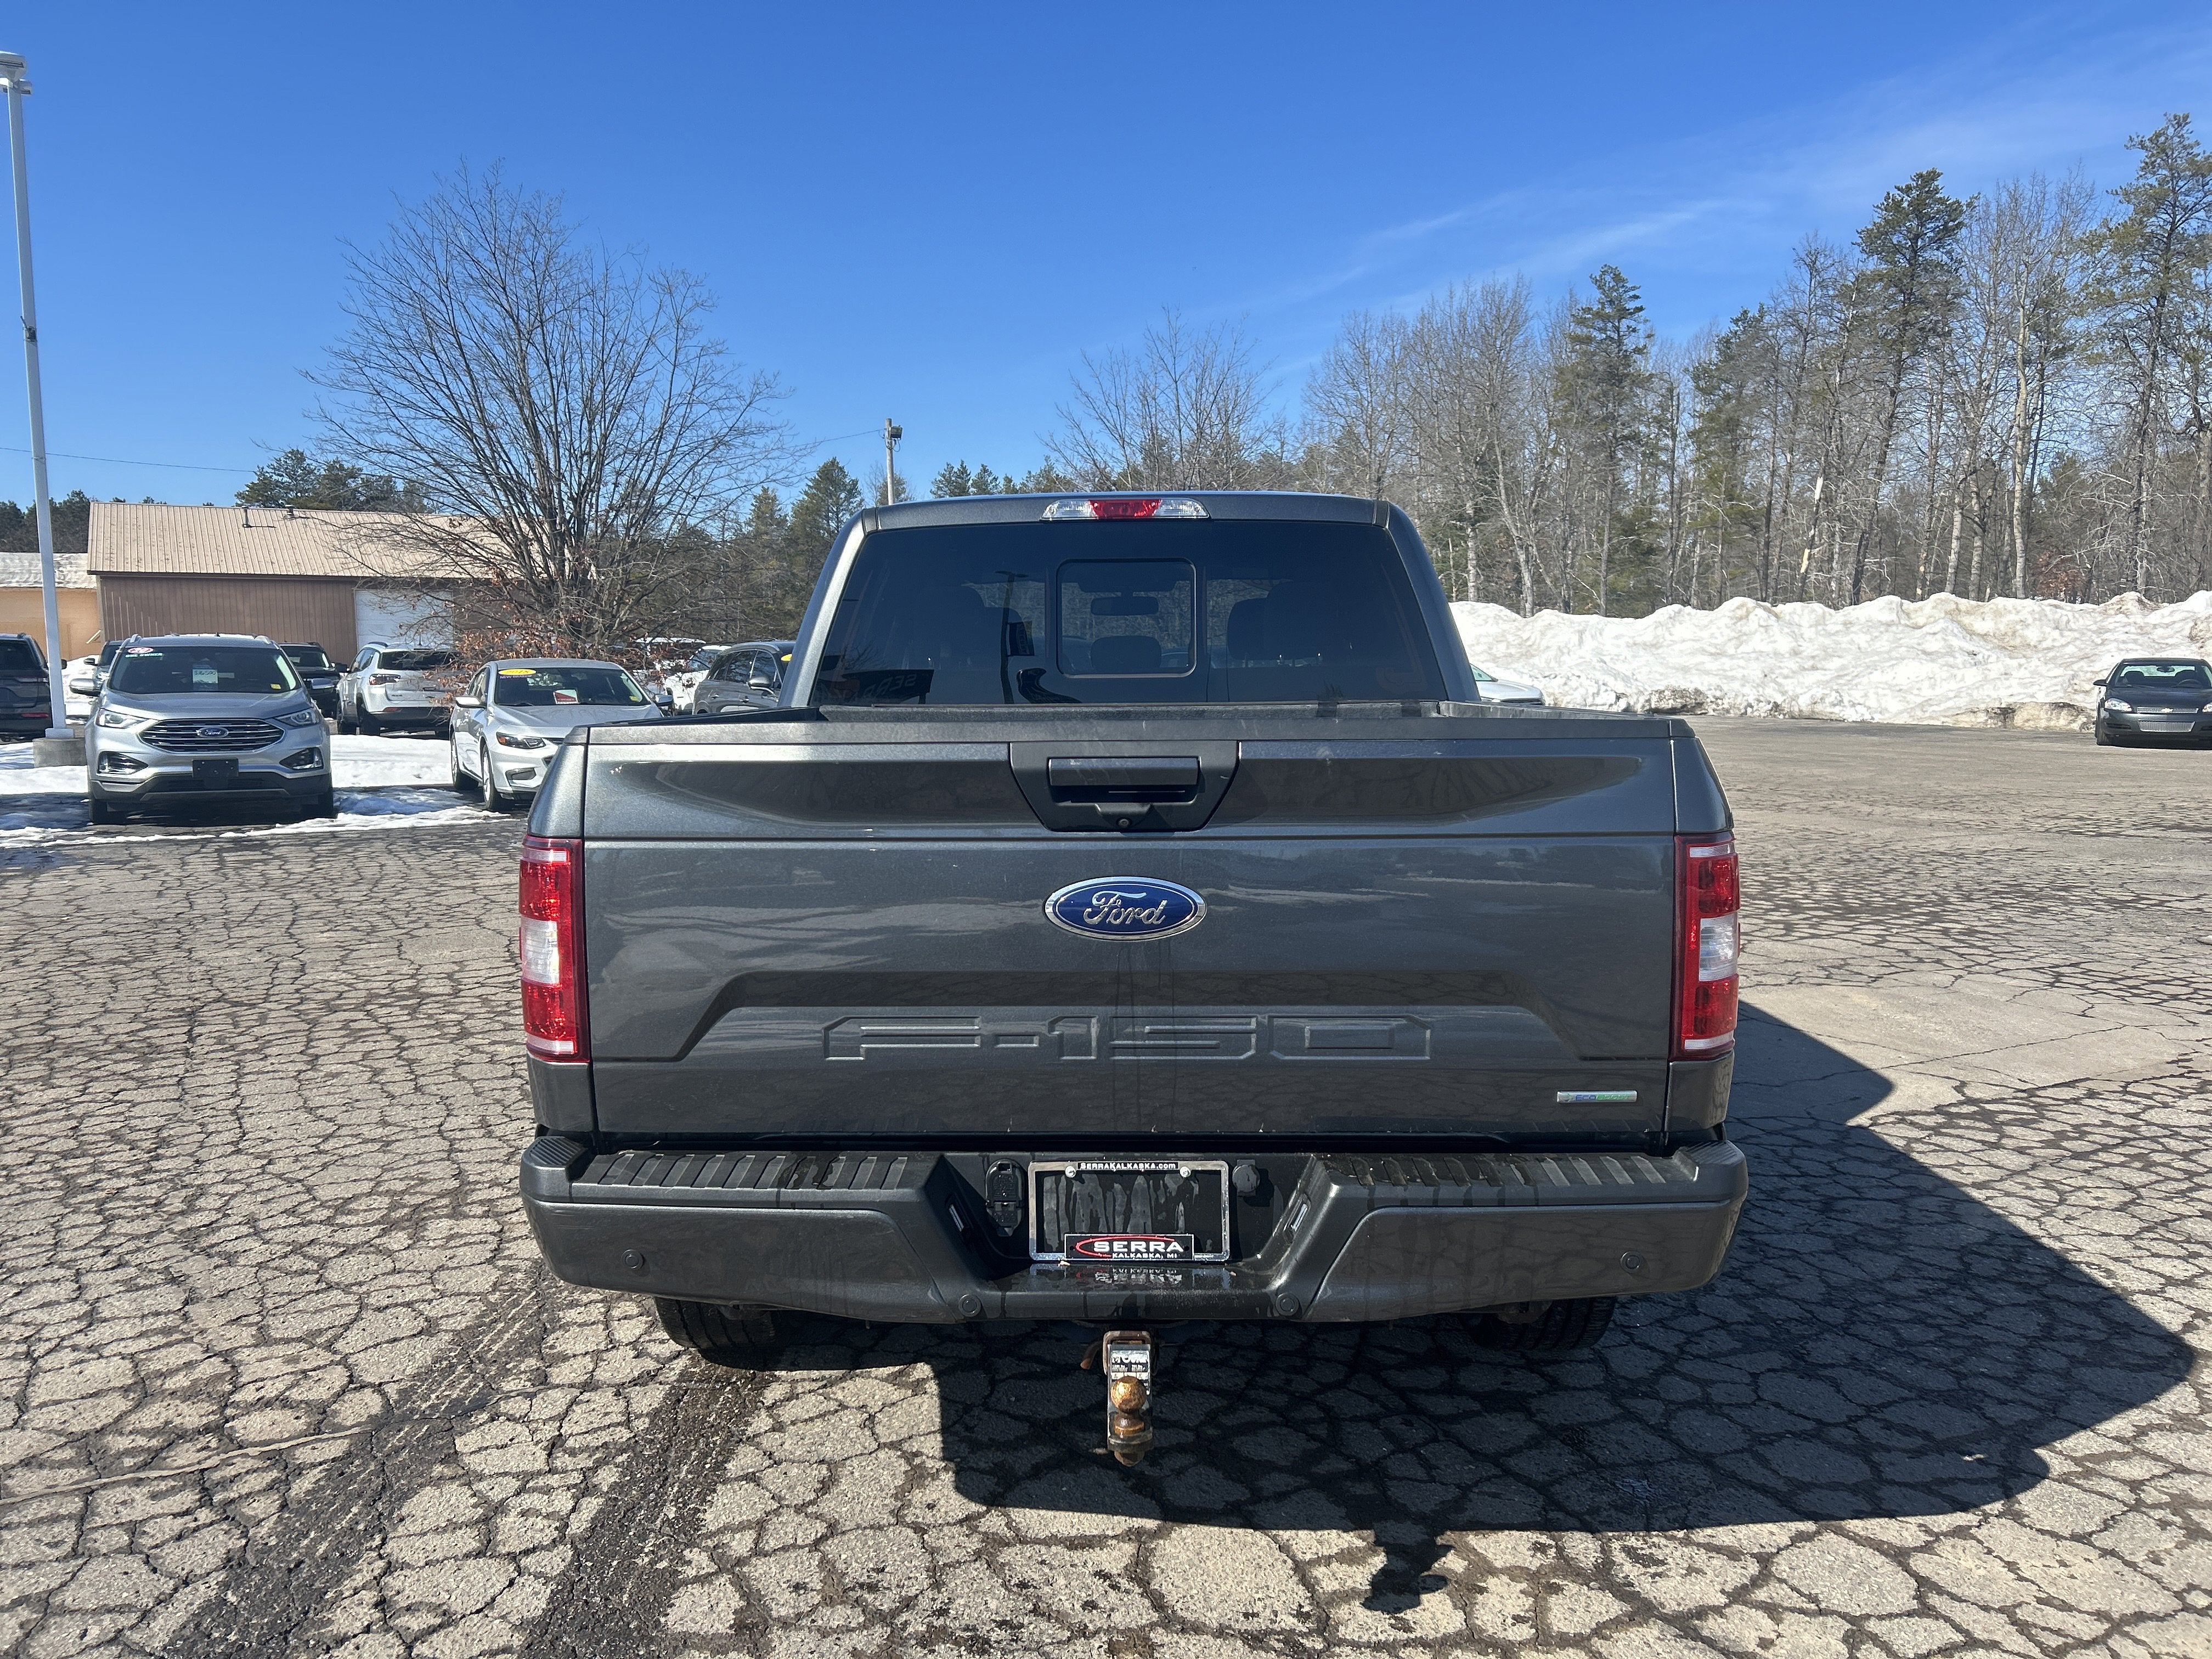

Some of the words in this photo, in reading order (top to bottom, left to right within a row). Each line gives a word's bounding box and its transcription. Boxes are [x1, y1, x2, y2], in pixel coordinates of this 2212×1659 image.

[1084, 890, 1168, 925] Ford
[822, 1014, 1432, 1060] F-150
[1093, 1241, 1184, 1252] SERRA
